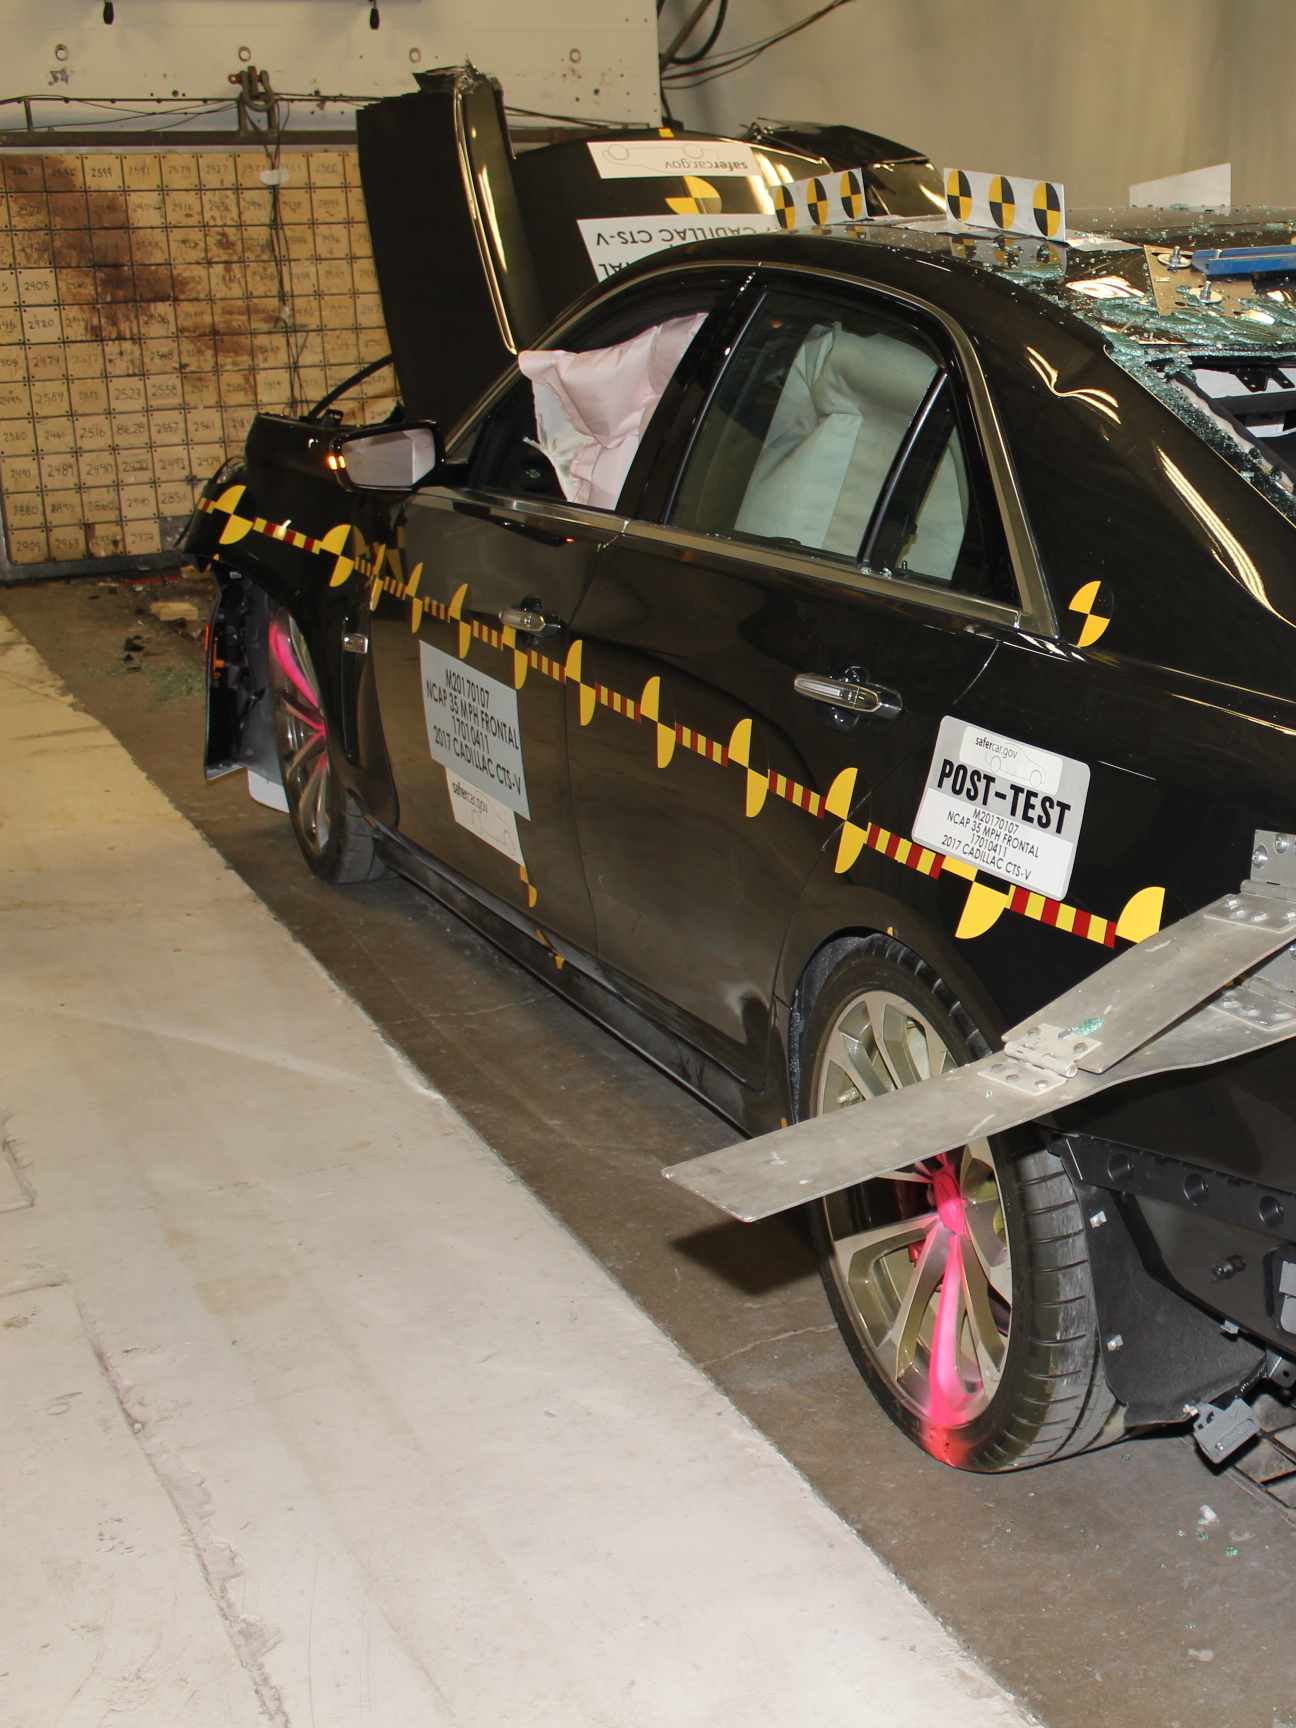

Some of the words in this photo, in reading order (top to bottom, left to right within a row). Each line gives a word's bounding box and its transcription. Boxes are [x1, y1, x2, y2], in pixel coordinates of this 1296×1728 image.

[168, 165, 191, 175] 2574
[664, 158, 749, 171] safercar.gov
[91, 166, 113, 178] 2599
[596, 229, 653, 247] CTS-V
[24, 280, 50, 292] 2905
[27, 318, 55, 331] 2920
[33, 354, 60, 368] 2474
[114, 388, 142, 402] 2523
[151, 385, 178, 398] 2558
[45, 429, 66, 442] 2461
[80, 426, 107, 441] 2516
[116, 422, 146, 436] 8628
[154, 422, 180, 435] 2557
[10, 469, 31, 480] 2491
[47, 462, 75, 479] 2489
[86, 462, 113, 476] 2490
[126, 497, 151, 509] 2940
[161, 492, 188, 506] 2851
[16, 540, 42, 553] 2909
[54, 538, 80, 551] 2963
[446, 668, 489, 709] M20170107
[426, 679, 448, 707] NCAP
[450, 692, 459, 714] 35
[461, 696, 479, 726] MPH
[481, 710, 519, 750] FRONTAL
[452, 716, 489, 754] 17010411
[975, 736, 1018, 759] safercar.gov
[434, 725, 451, 752] 2017
[453, 737, 494, 779] CADILLAC
[496, 763, 521, 795] CTS-V
[452, 781, 488, 813] safercar.gov
[937, 758, 1071, 834] POST-TEST
[972, 809, 1019, 834] M20170107
[947, 810, 971, 829] NCAP
[971, 821, 981, 832] 35
[983, 824, 1000, 840] MPH
[1003, 833, 1039, 858] FRONTAL
[971, 833, 1007, 858] 17010411
[941, 835, 962, 850] 2017
[962, 843, 1003, 869] CADILLAC
[1005, 861, 1031, 880] CTS-V
